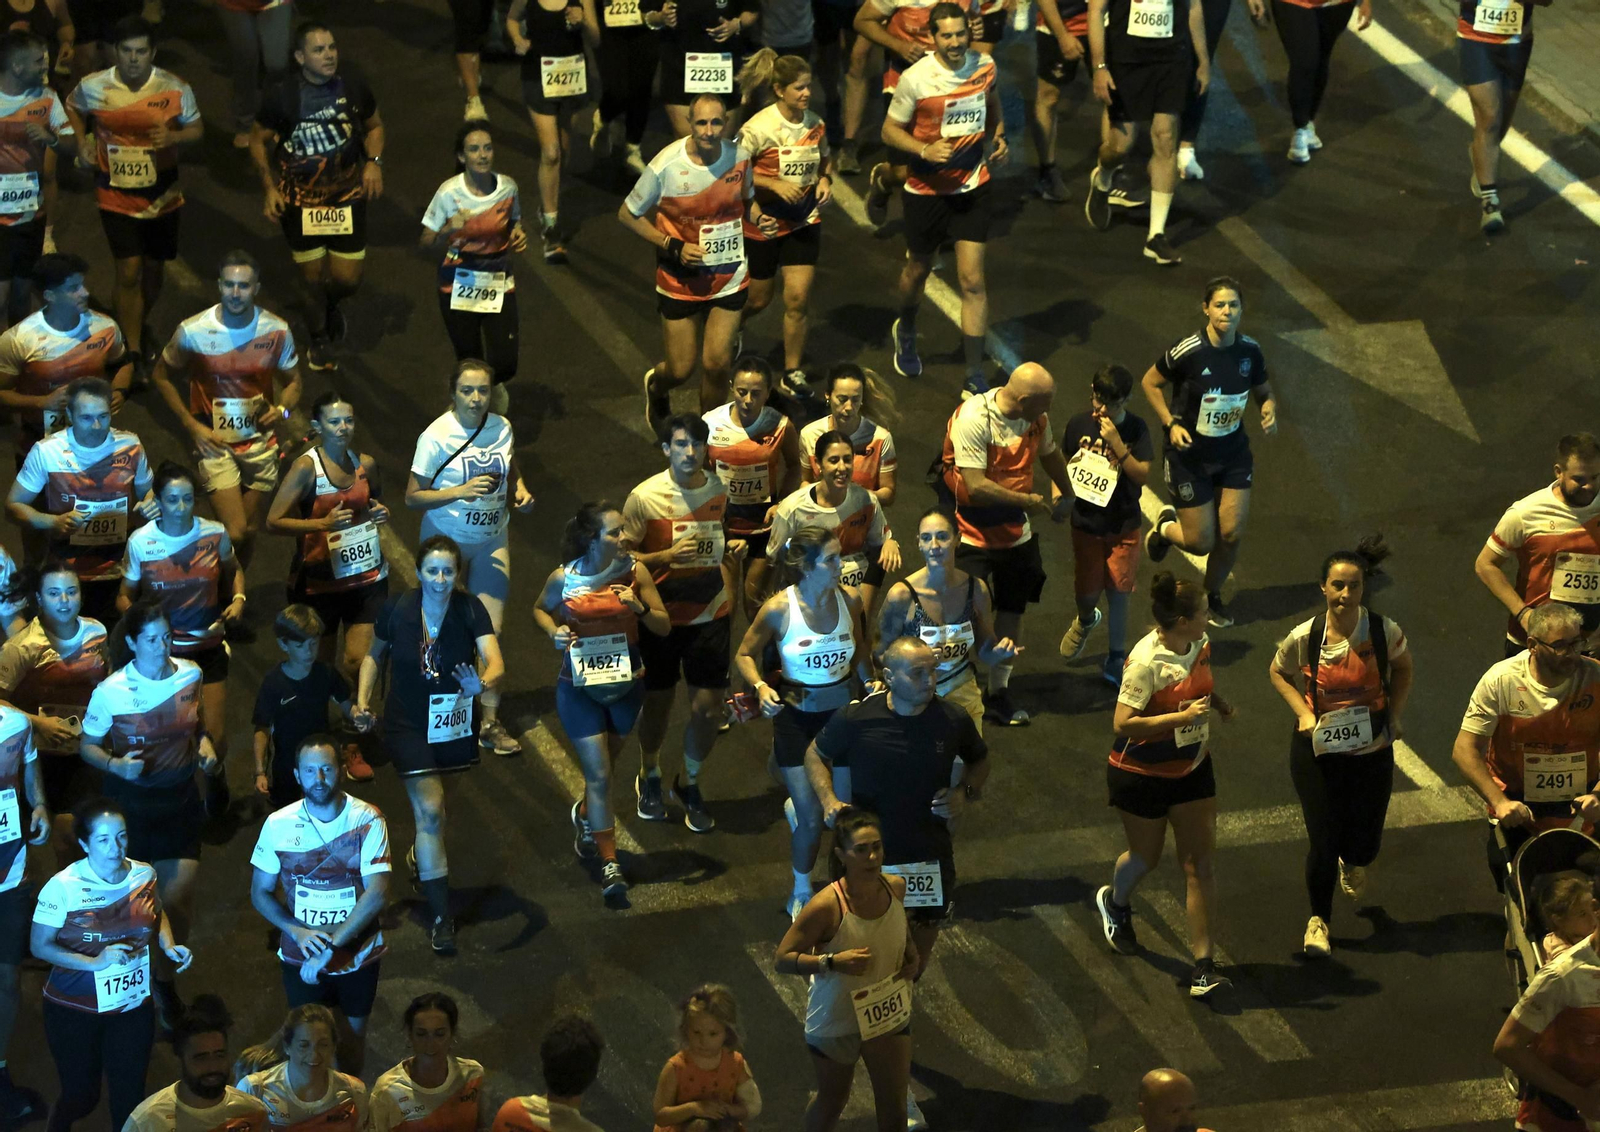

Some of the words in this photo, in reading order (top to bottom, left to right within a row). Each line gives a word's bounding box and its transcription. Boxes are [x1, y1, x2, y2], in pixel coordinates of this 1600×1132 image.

[1133, 11, 1169, 26] 20680
[1482, 8, 1517, 23] 14413
[546, 71, 581, 85] 24277
[690, 69, 726, 81] 22238
[946, 110, 982, 125] 22392
[113, 162, 149, 176] 24321
[2, 189, 32, 202] 8940
[308, 209, 346, 223] 10406
[705, 237, 739, 253] 23515
[457, 286, 497, 301] 22799
[1205, 408, 1240, 425] 15925
[729, 479, 763, 494] 5774
[1071, 466, 1109, 492] 15248
[84, 518, 117, 532] 7891
[465, 510, 499, 526] 19296
[341, 542, 373, 563] 6884
[697, 540, 714, 555] 88
[839, 571, 864, 587] 829
[1563, 573, 1599, 591] 2535
[578, 654, 622, 673] 14527
[804, 651, 847, 669] 19325
[434, 709, 467, 729] 24080
[127, 735, 145, 745] 37
[1322, 724, 1361, 743] 2494
[1535, 773, 1573, 789] 2491
[902, 875, 934, 892] 562
[301, 908, 348, 926] 17573
[82, 932, 102, 942] 37
[104, 969, 144, 996] 17543
[864, 992, 903, 1024] 10561
